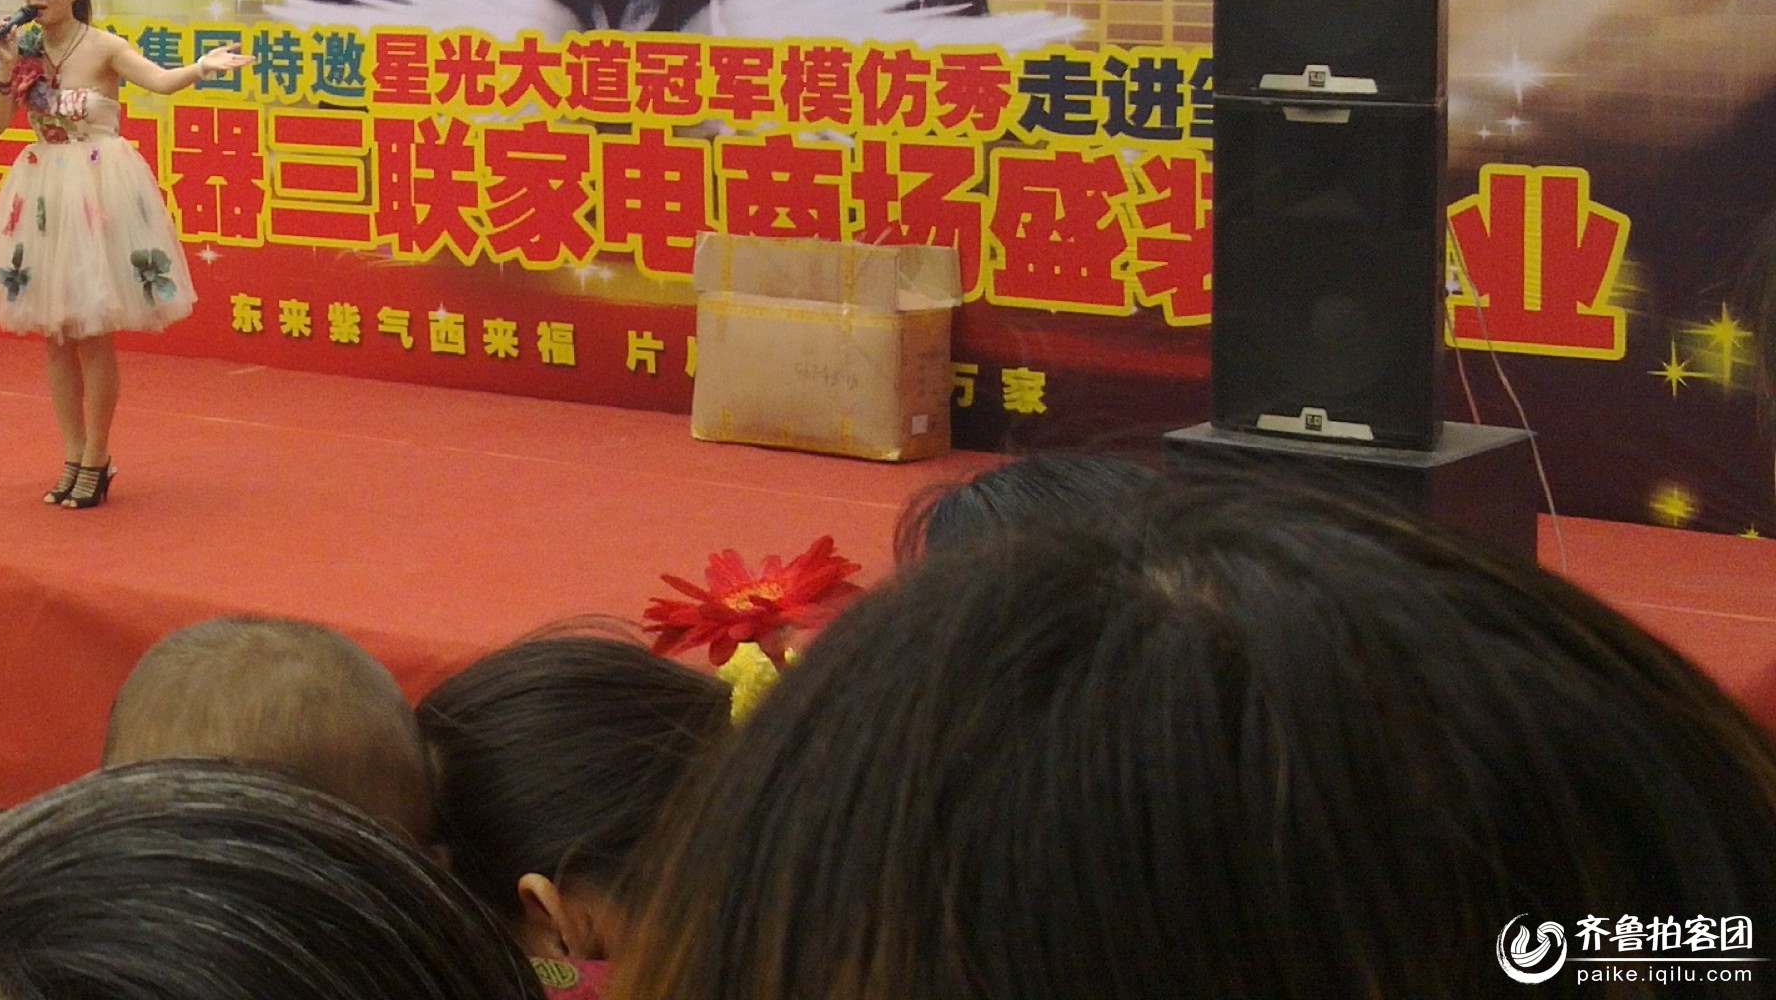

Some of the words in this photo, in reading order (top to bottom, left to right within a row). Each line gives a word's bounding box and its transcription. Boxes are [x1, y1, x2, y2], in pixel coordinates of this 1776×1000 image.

[27, 18, 1213, 141] 集团特邀星光大道冠军模仿秀走进
[230, 293, 576, 366] 东来紫气西来福
